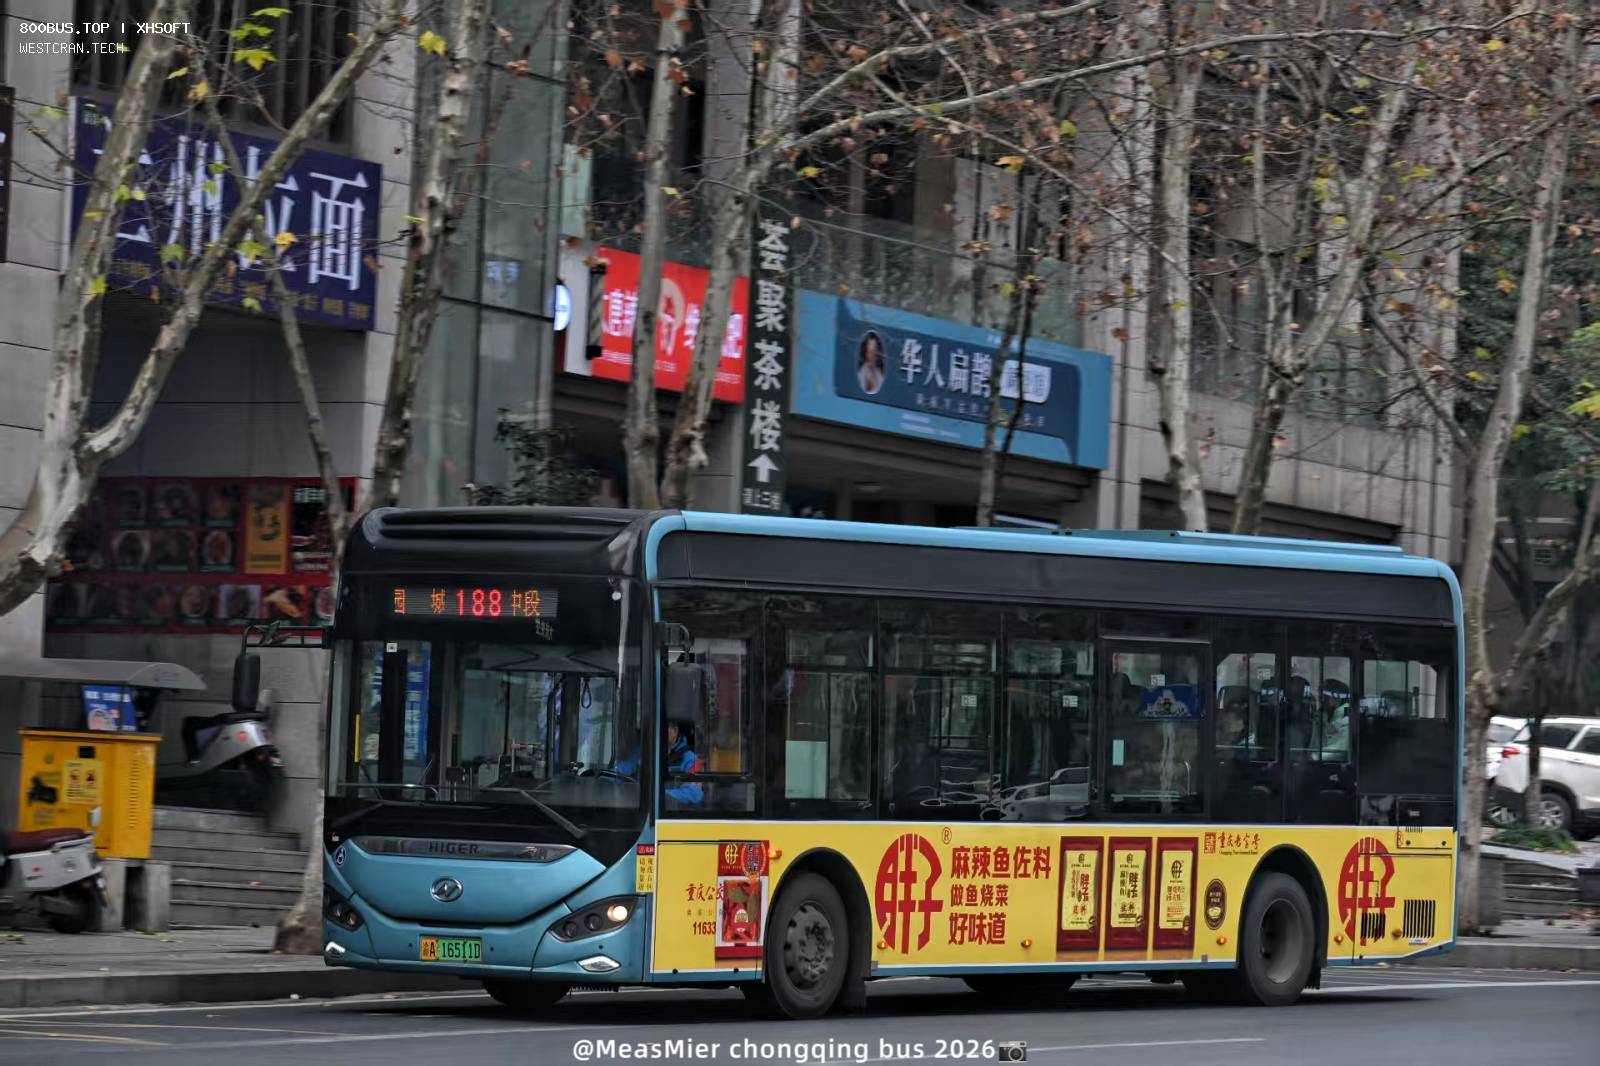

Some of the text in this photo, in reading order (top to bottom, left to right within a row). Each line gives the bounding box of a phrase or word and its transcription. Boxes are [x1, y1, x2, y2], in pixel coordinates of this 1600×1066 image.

[750, 219, 790, 453] 荟聚茶楼
[456, 588, 502, 616] 188
[429, 841, 480, 855] HIGER
[950, 846, 1052, 879] 麻辣鱼佐料
[950, 884, 1009, 907] 做鱼烧菜
[948, 912, 1007, 945] 好味道
